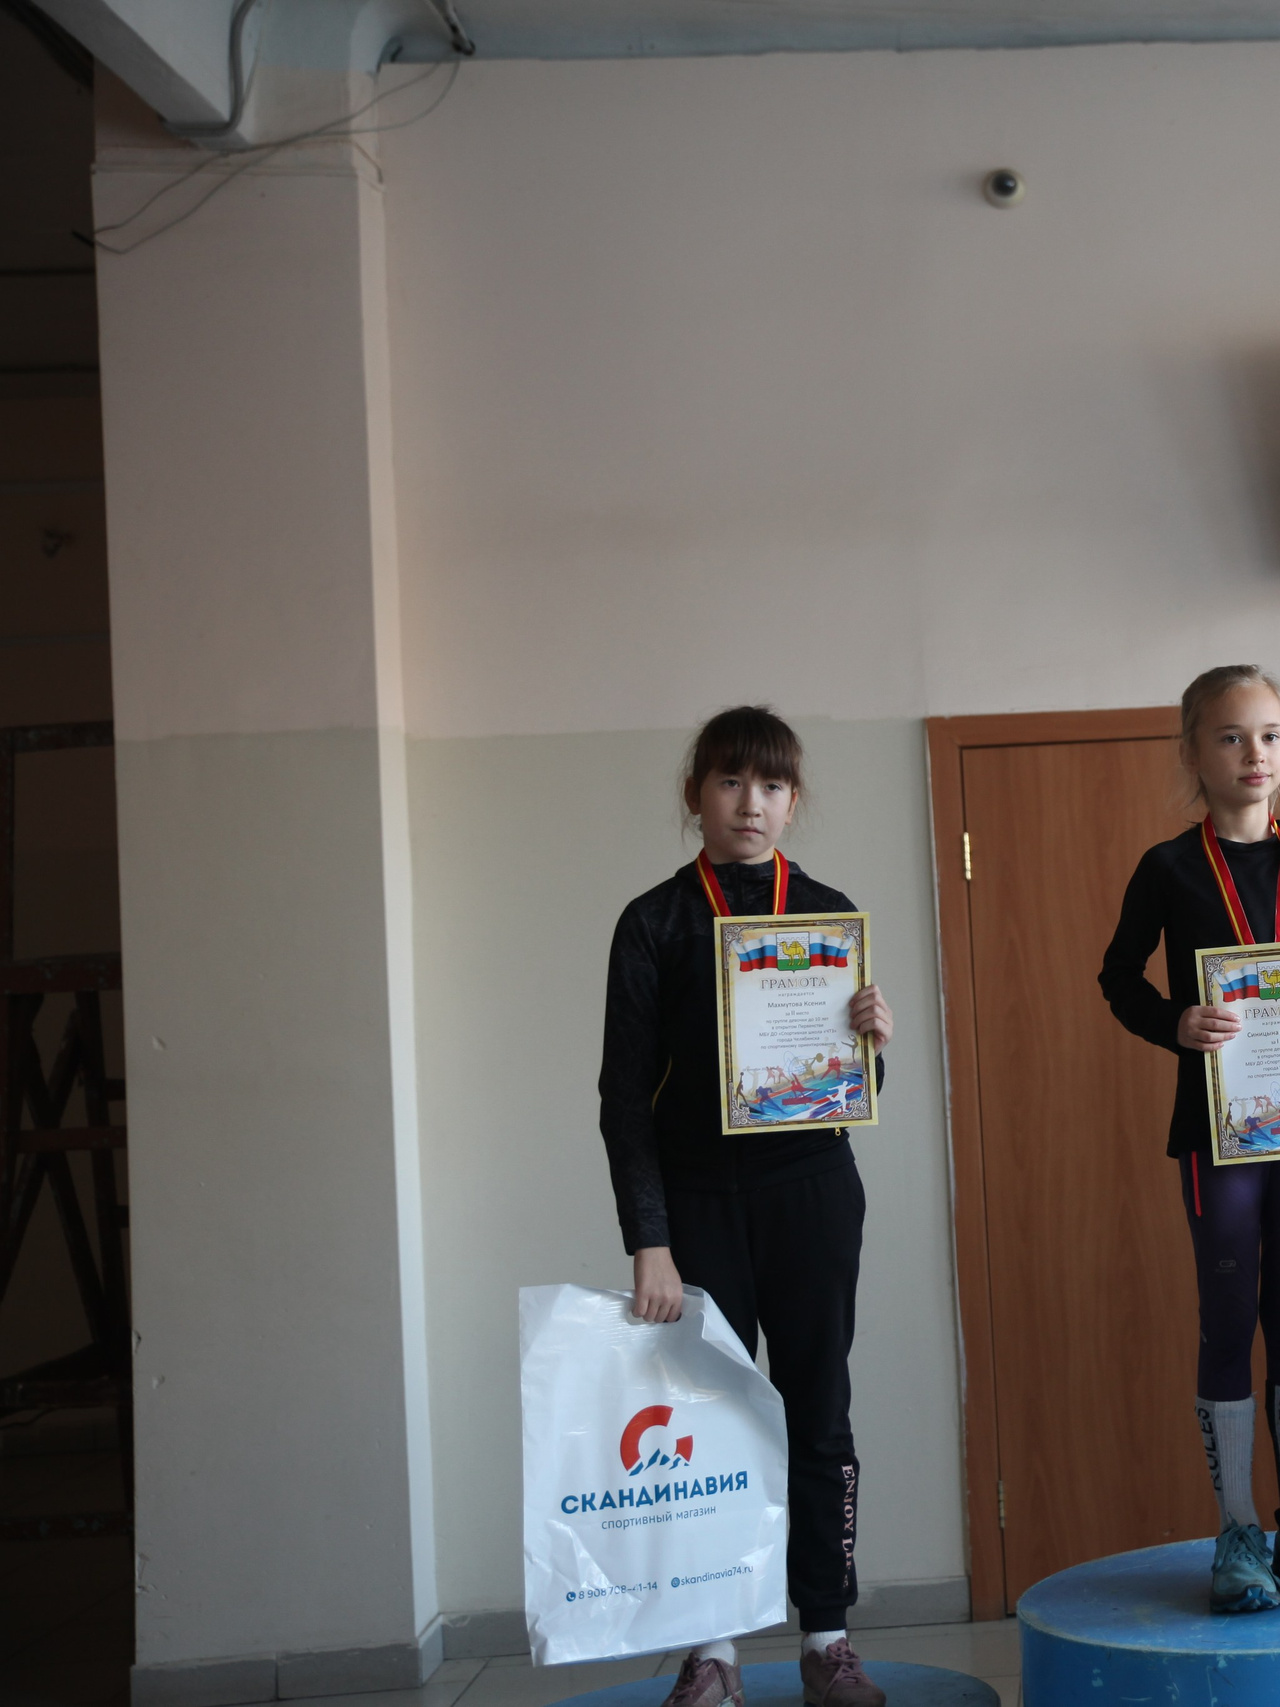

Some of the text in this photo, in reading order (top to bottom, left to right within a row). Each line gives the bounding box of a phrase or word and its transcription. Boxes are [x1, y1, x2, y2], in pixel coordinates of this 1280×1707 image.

[761, 977, 827, 989] ГРАМОТА
[1247, 1030, 1279, 1038] Синицына
[560, 1470, 748, 1514] СКАНДИНАВИЯ
[842, 1464, 856, 1532] ENJOY
[601, 1506, 716, 1530] спортивный магазин
[578, 1590, 585, 1600] 8
[587, 1588, 606, 1598] 908
